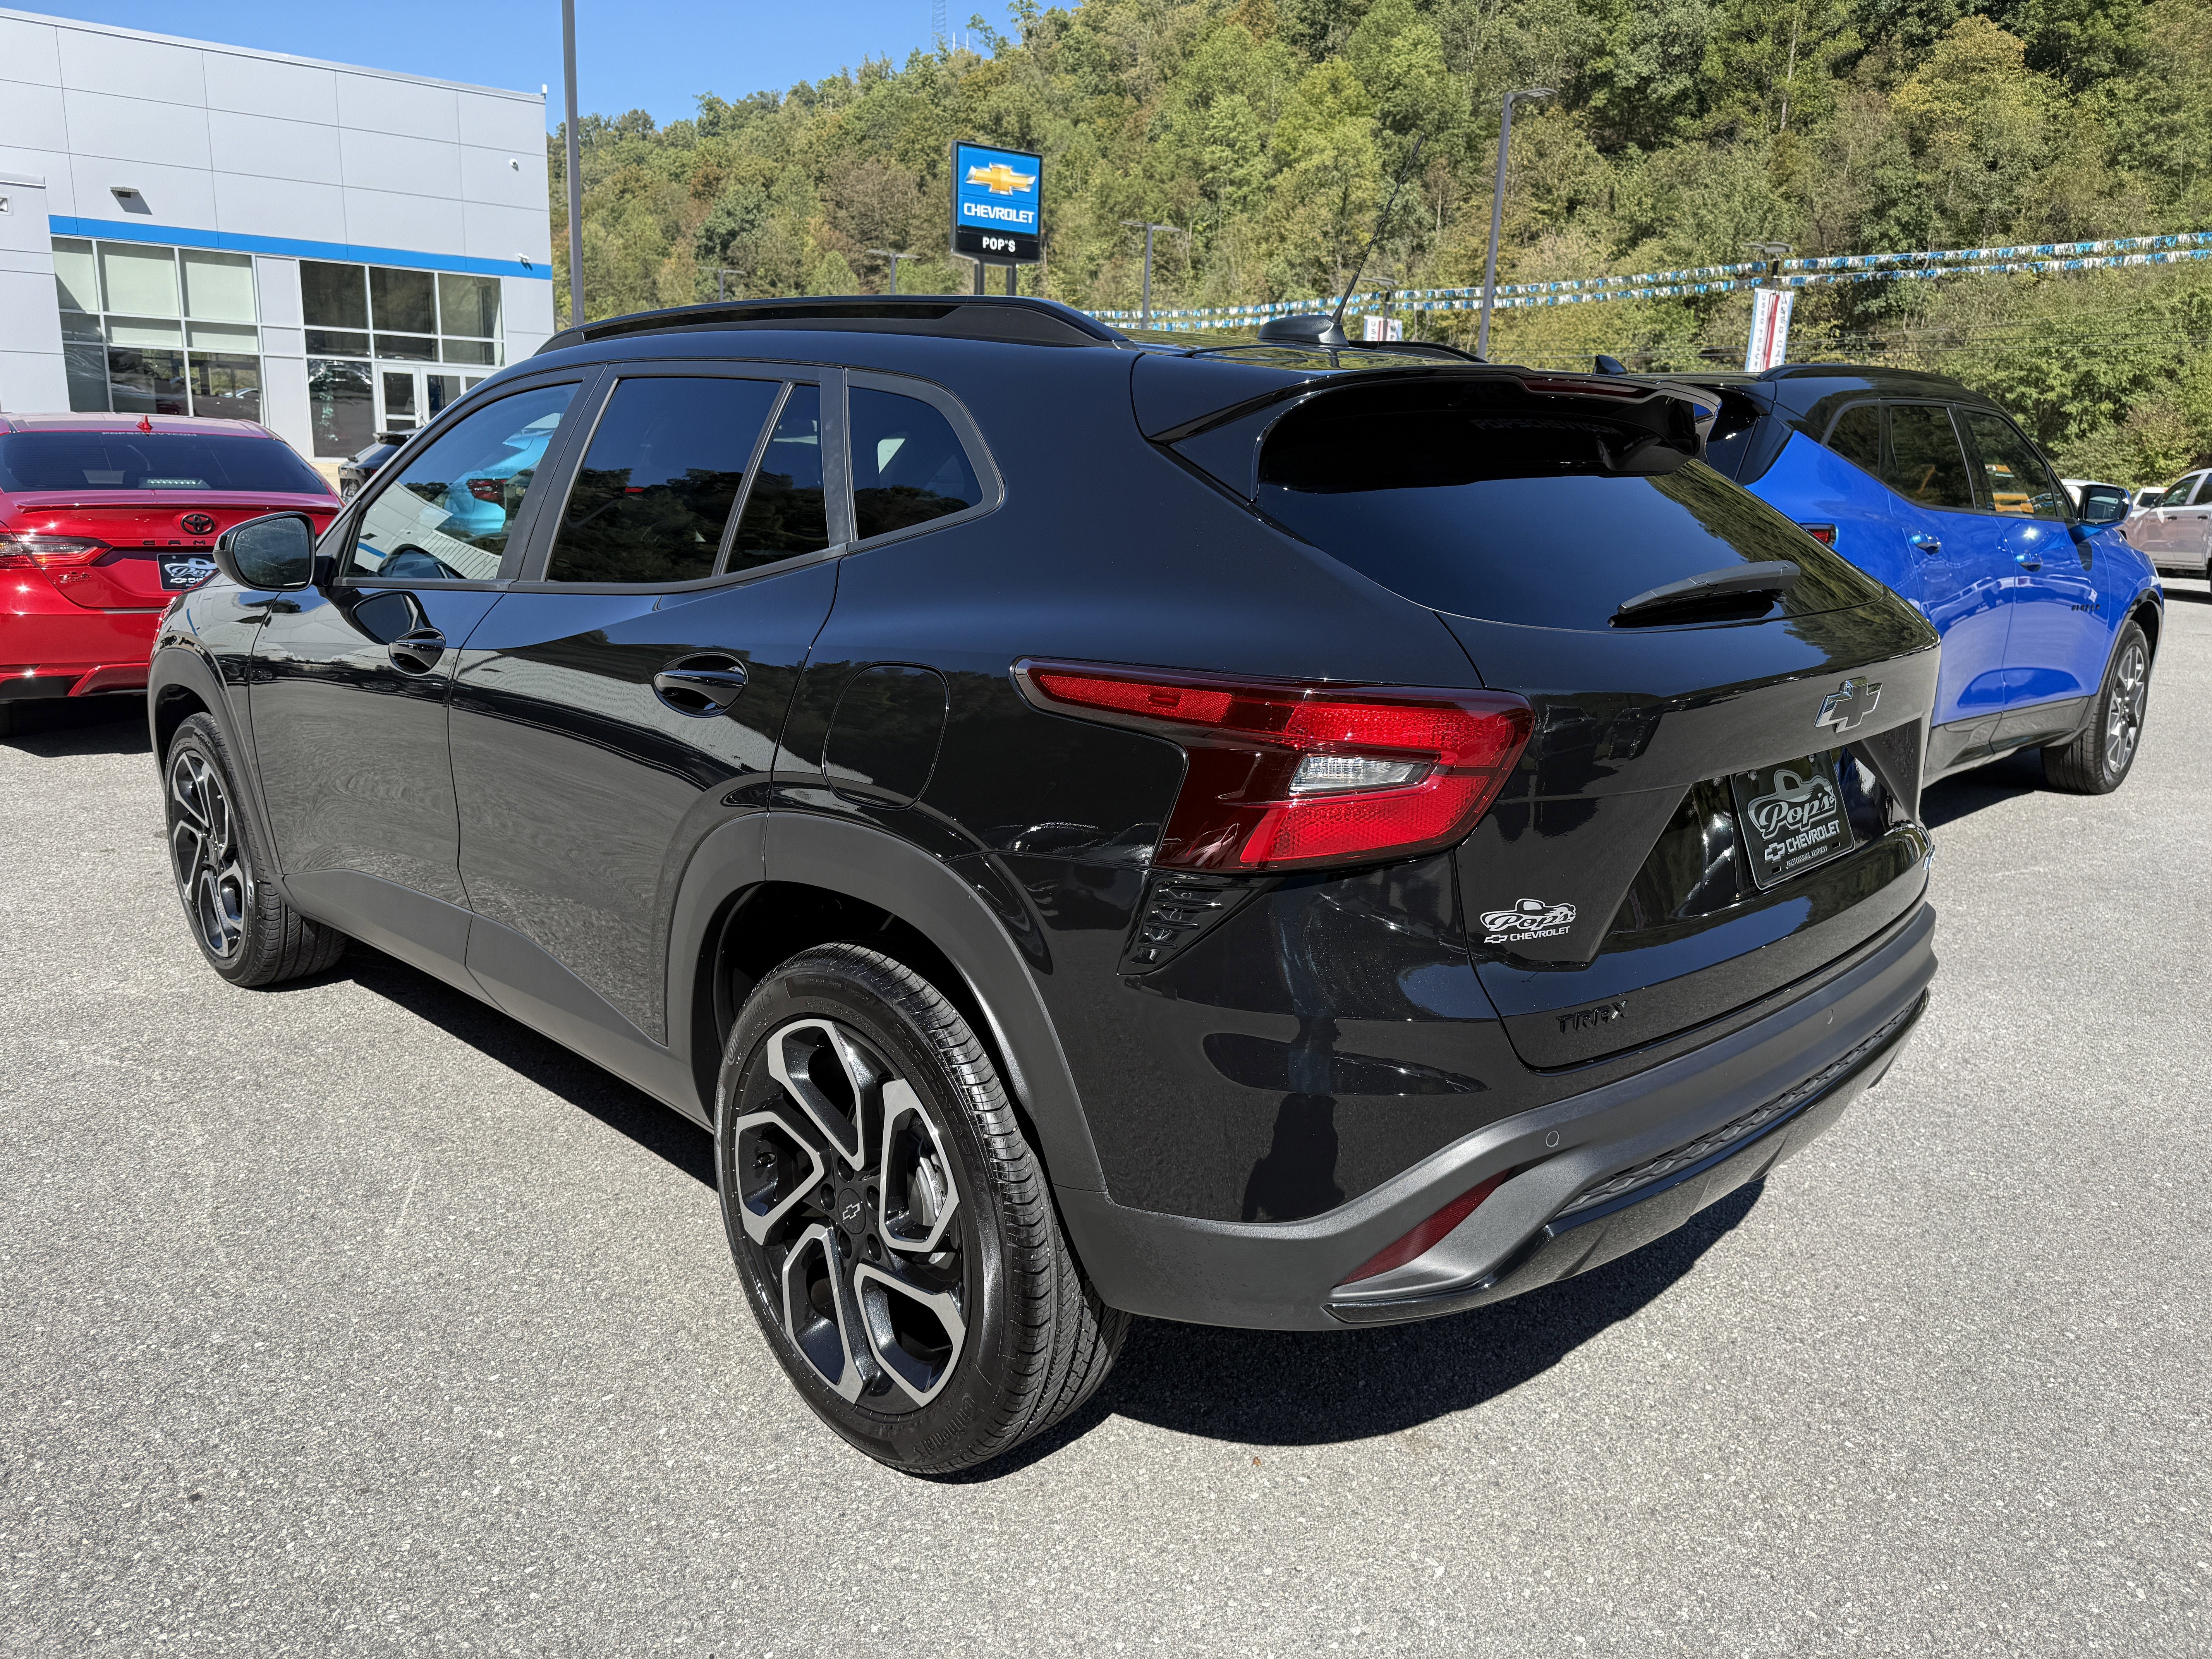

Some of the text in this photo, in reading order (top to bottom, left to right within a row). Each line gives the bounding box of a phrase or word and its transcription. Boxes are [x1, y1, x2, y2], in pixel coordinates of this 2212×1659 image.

[963, 203, 1035, 224] CHEVROLET
[982, 235, 1016, 252] POP'S
[1759, 792, 1835, 833] Pop's
[1786, 819, 1840, 853] CHEVROLET
[1510, 926, 1571, 941] CHEVROLET
[1556, 999, 1629, 1034] TRAX
